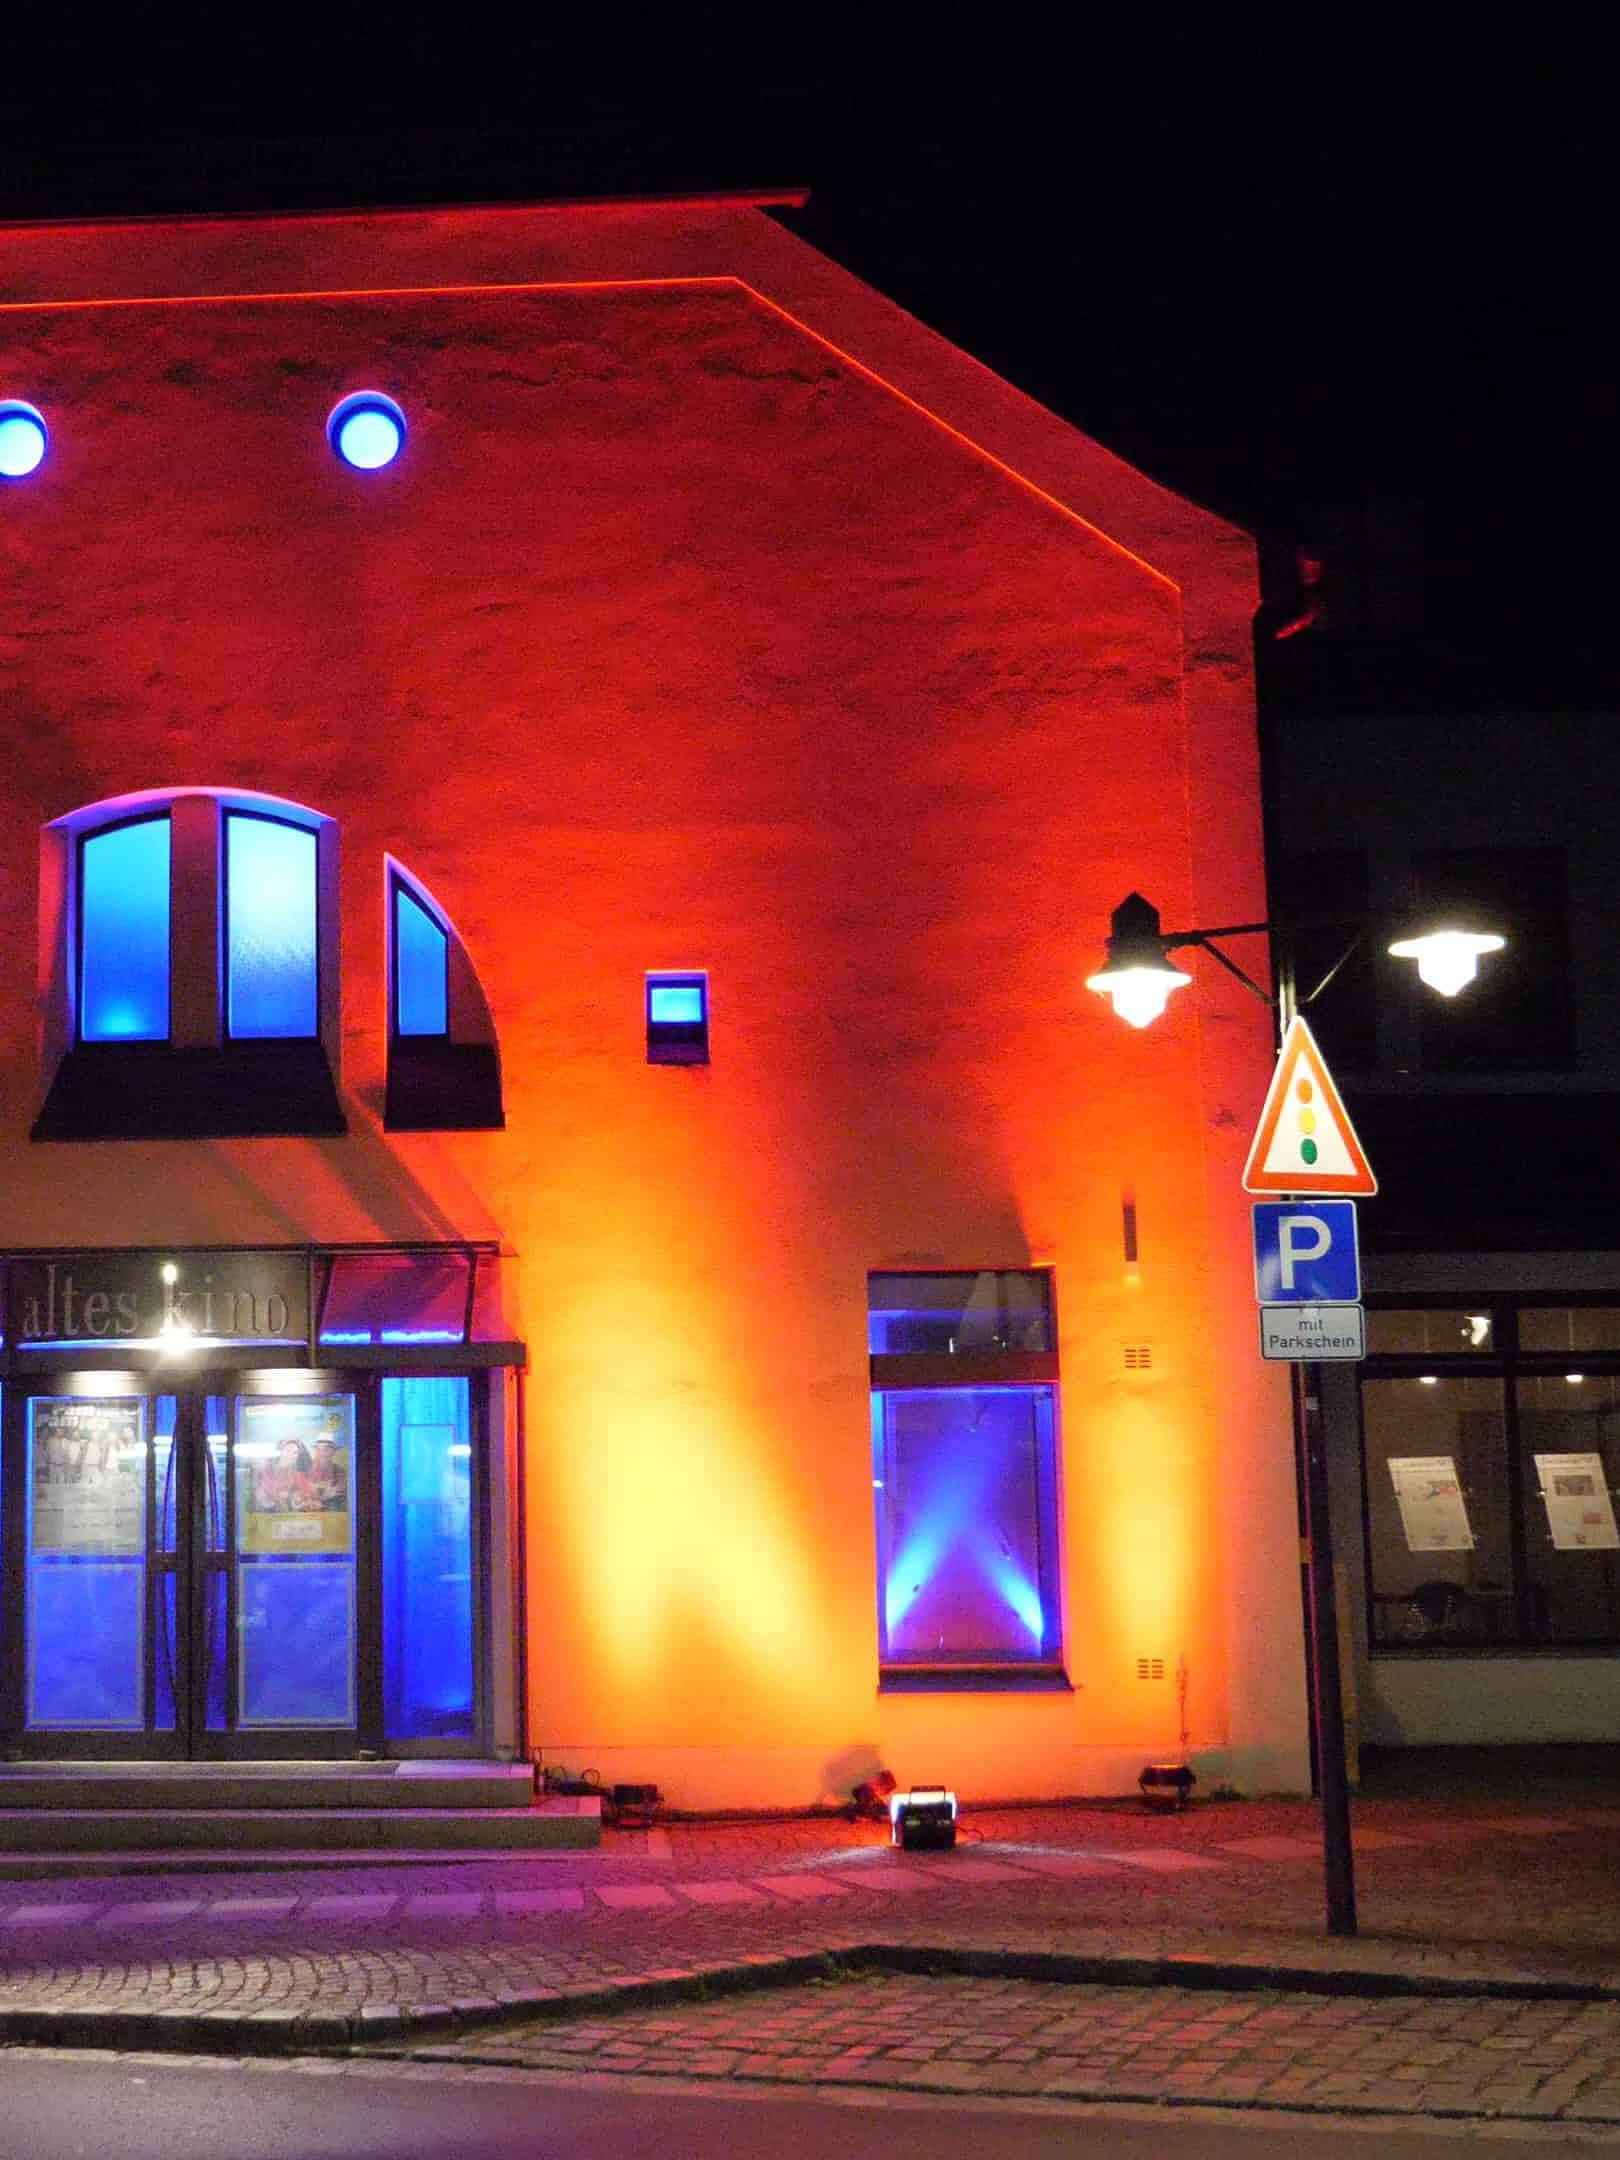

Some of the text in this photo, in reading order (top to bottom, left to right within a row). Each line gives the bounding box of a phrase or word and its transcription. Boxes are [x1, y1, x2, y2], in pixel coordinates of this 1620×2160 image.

[1278, 1215, 1332, 1289] P
[23, 1263, 138, 1337] altes
[1269, 1334, 1356, 1350] Parkschein
[1298, 1317, 1324, 1331] mit
